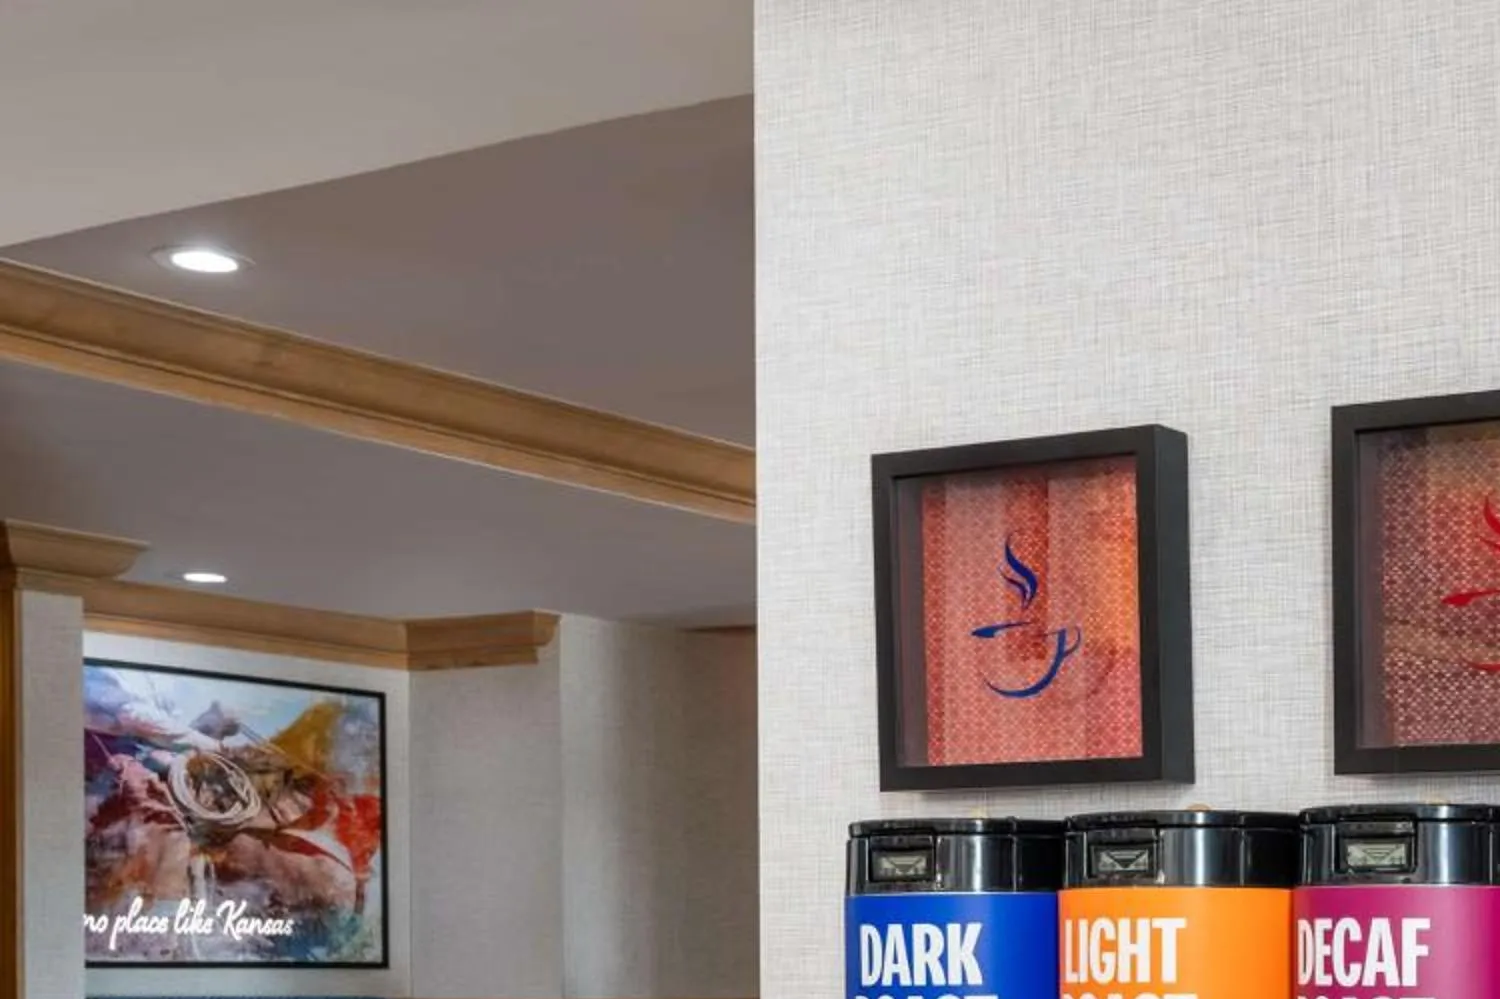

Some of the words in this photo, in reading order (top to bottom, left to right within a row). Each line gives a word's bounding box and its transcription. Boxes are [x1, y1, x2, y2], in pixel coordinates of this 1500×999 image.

[108, 896, 168, 950] place
[174, 899, 213, 936] like
[217, 900, 294, 940] Kansas
[859, 923, 984, 987] DARK
[1064, 917, 1187, 984] LIGHT
[1297, 917, 1431, 988] DECAF
